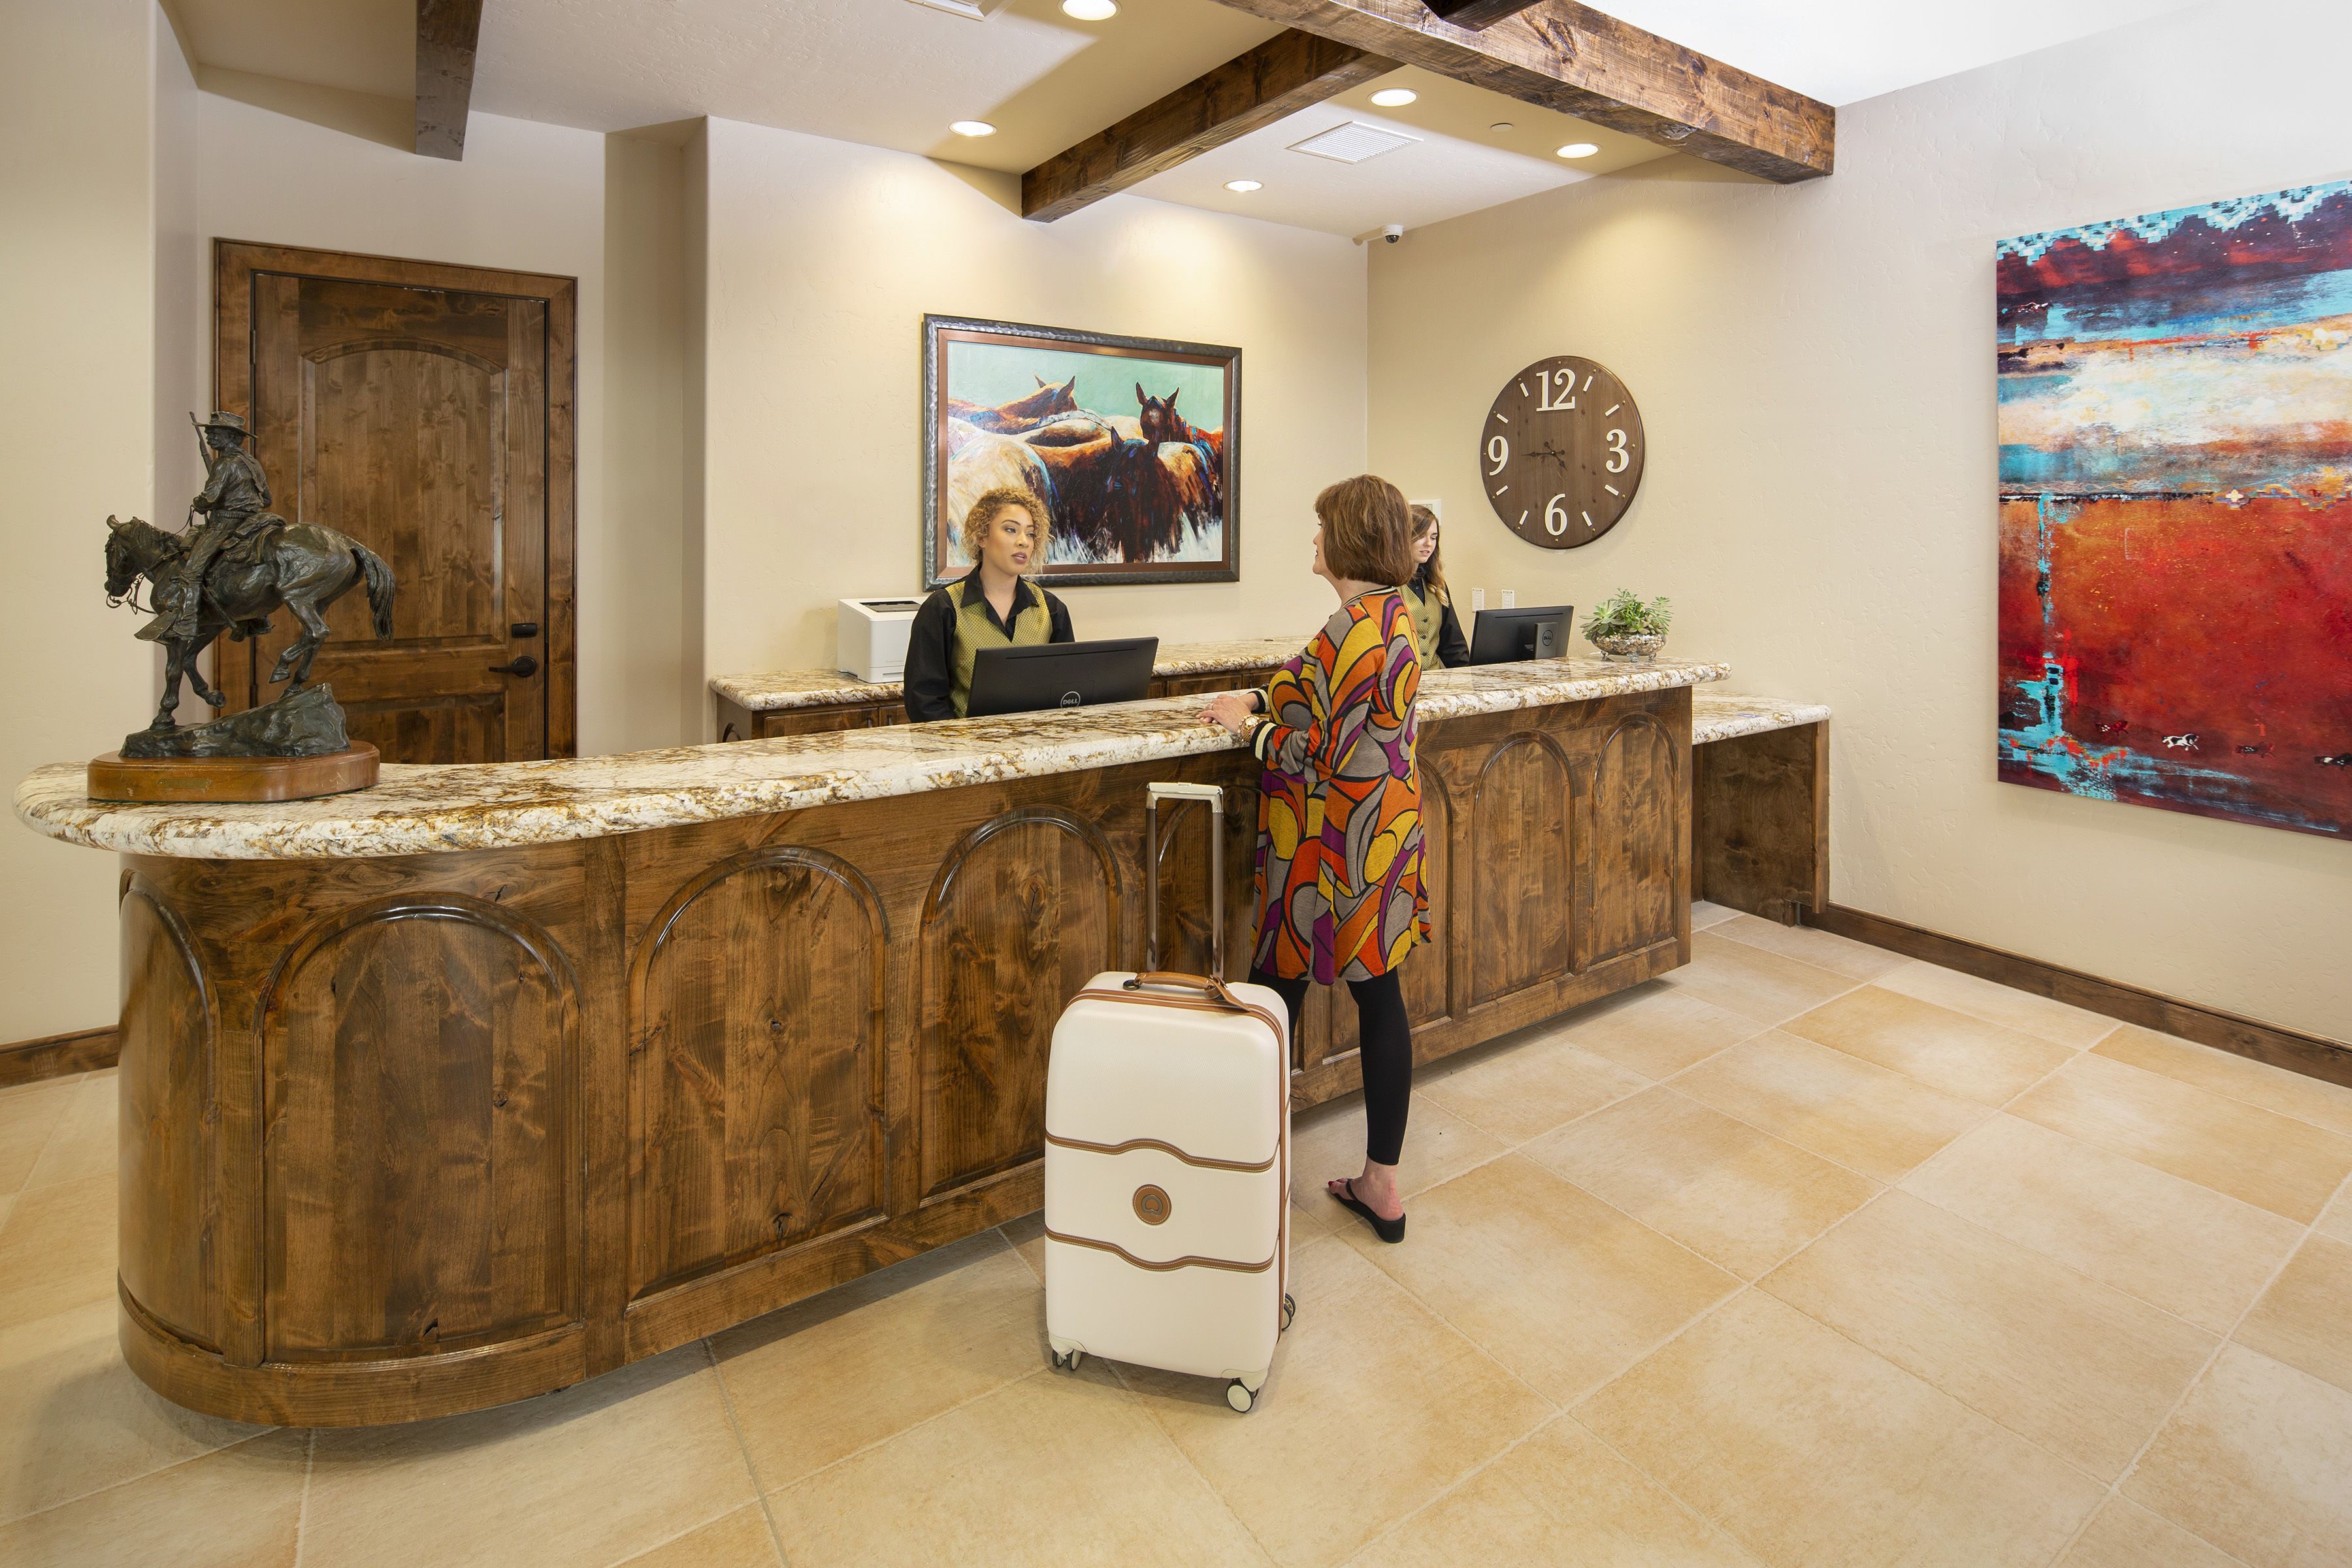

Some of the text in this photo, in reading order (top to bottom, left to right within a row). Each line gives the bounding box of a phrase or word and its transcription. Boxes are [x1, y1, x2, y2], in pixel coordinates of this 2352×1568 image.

[1536, 368, 1576, 412] 12
[1488, 436, 1509, 476] 9
[1606, 429, 1629, 473] 3
[1544, 493, 1567, 536] 6
